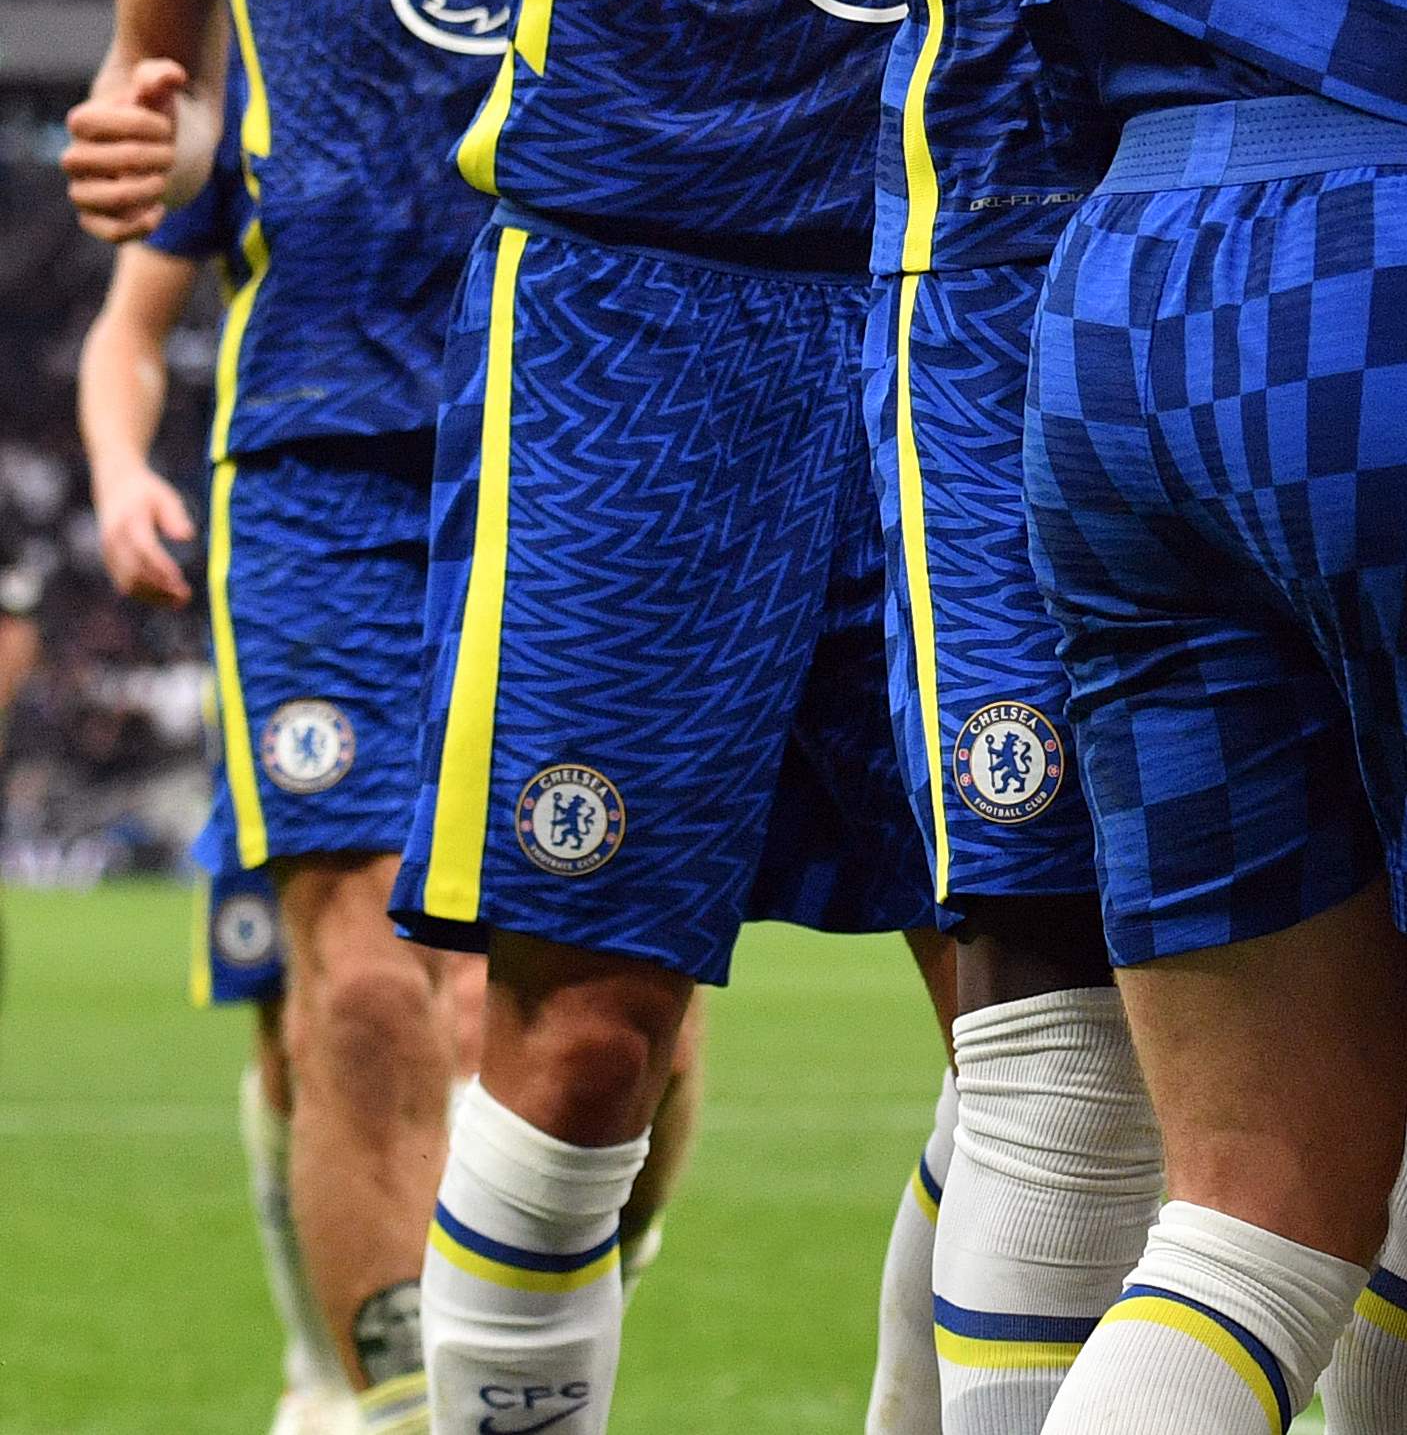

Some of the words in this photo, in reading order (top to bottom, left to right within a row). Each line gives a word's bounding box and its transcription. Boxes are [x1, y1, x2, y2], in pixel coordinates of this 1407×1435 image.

[969, 706, 1039, 735] CHELSEA
[539, 769, 609, 798] CHELSEA
[974, 797, 1022, 818] FOOTBALL
[1024, 791, 1048, 812] CLUB
